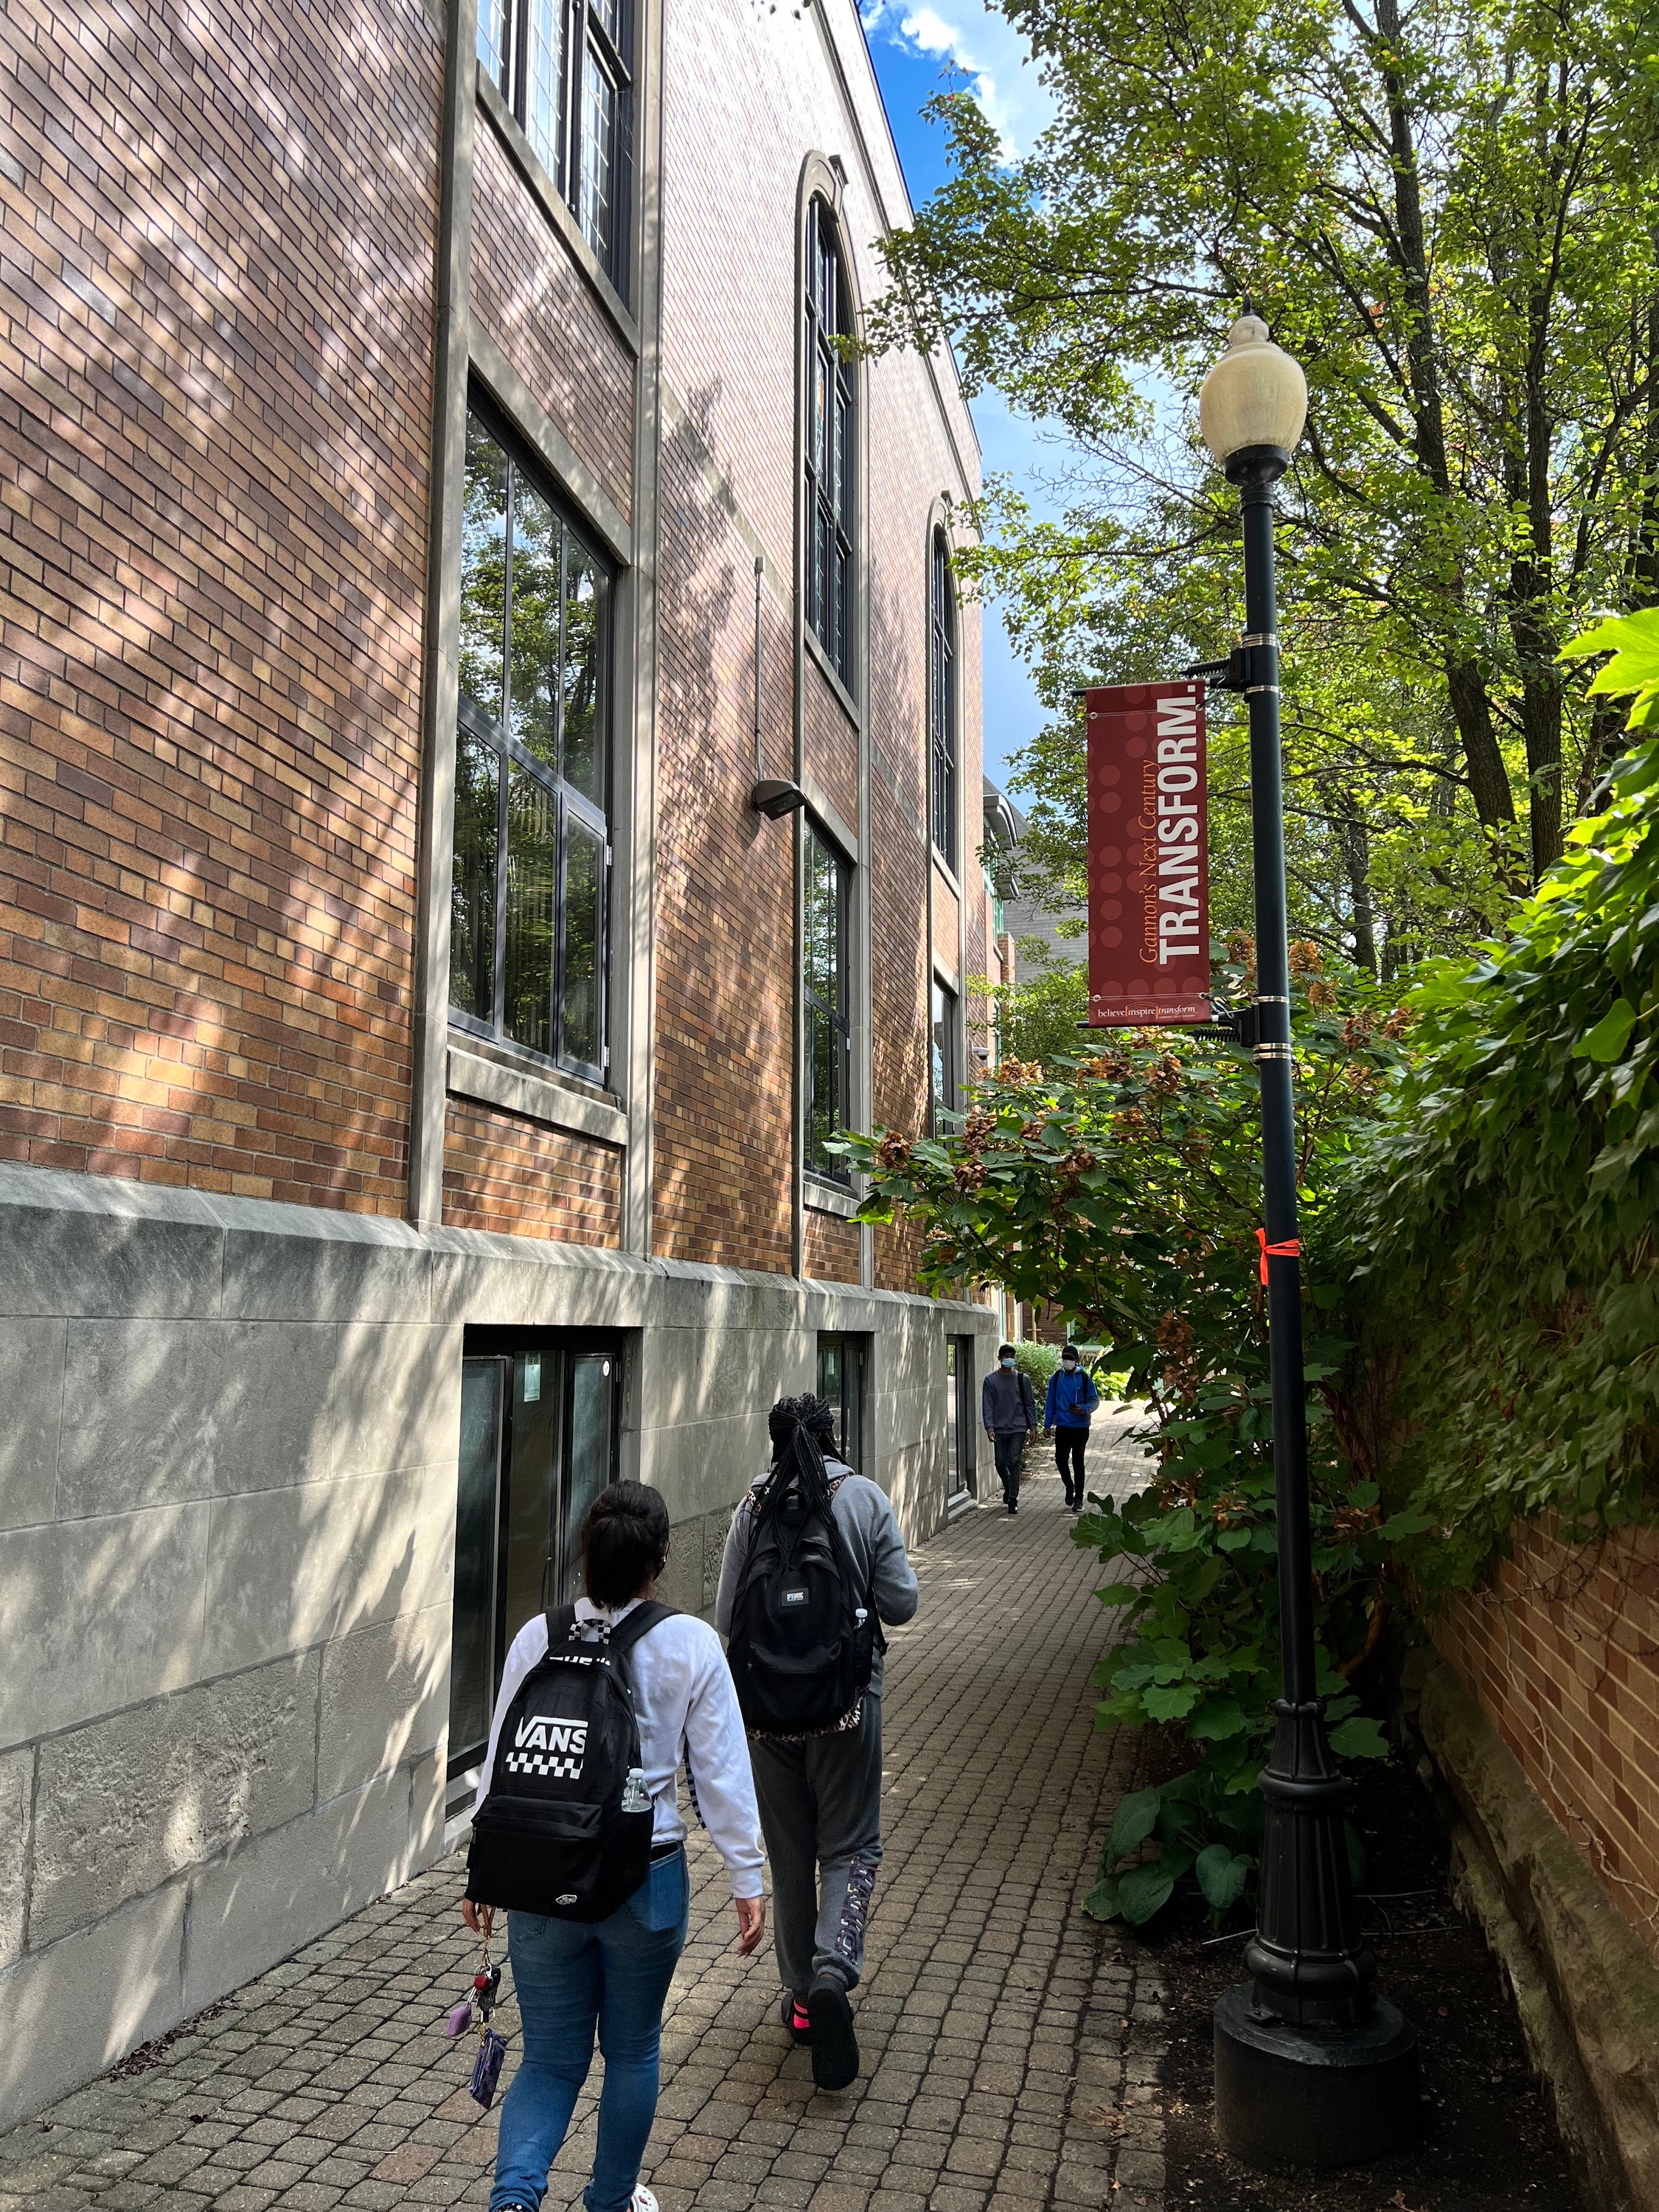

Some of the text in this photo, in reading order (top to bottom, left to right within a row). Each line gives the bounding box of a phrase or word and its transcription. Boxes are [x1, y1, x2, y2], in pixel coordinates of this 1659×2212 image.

[1138, 759, 1161, 964] Gannon's Next Century
[1156, 684, 1200, 965] TRANSFORM.
[1098, 1008, 1124, 1017] believe
[1128, 1007, 1155, 1018] inspire
[1158, 1004, 1195, 1015] transform
[515, 1715, 588, 1754] VANS
